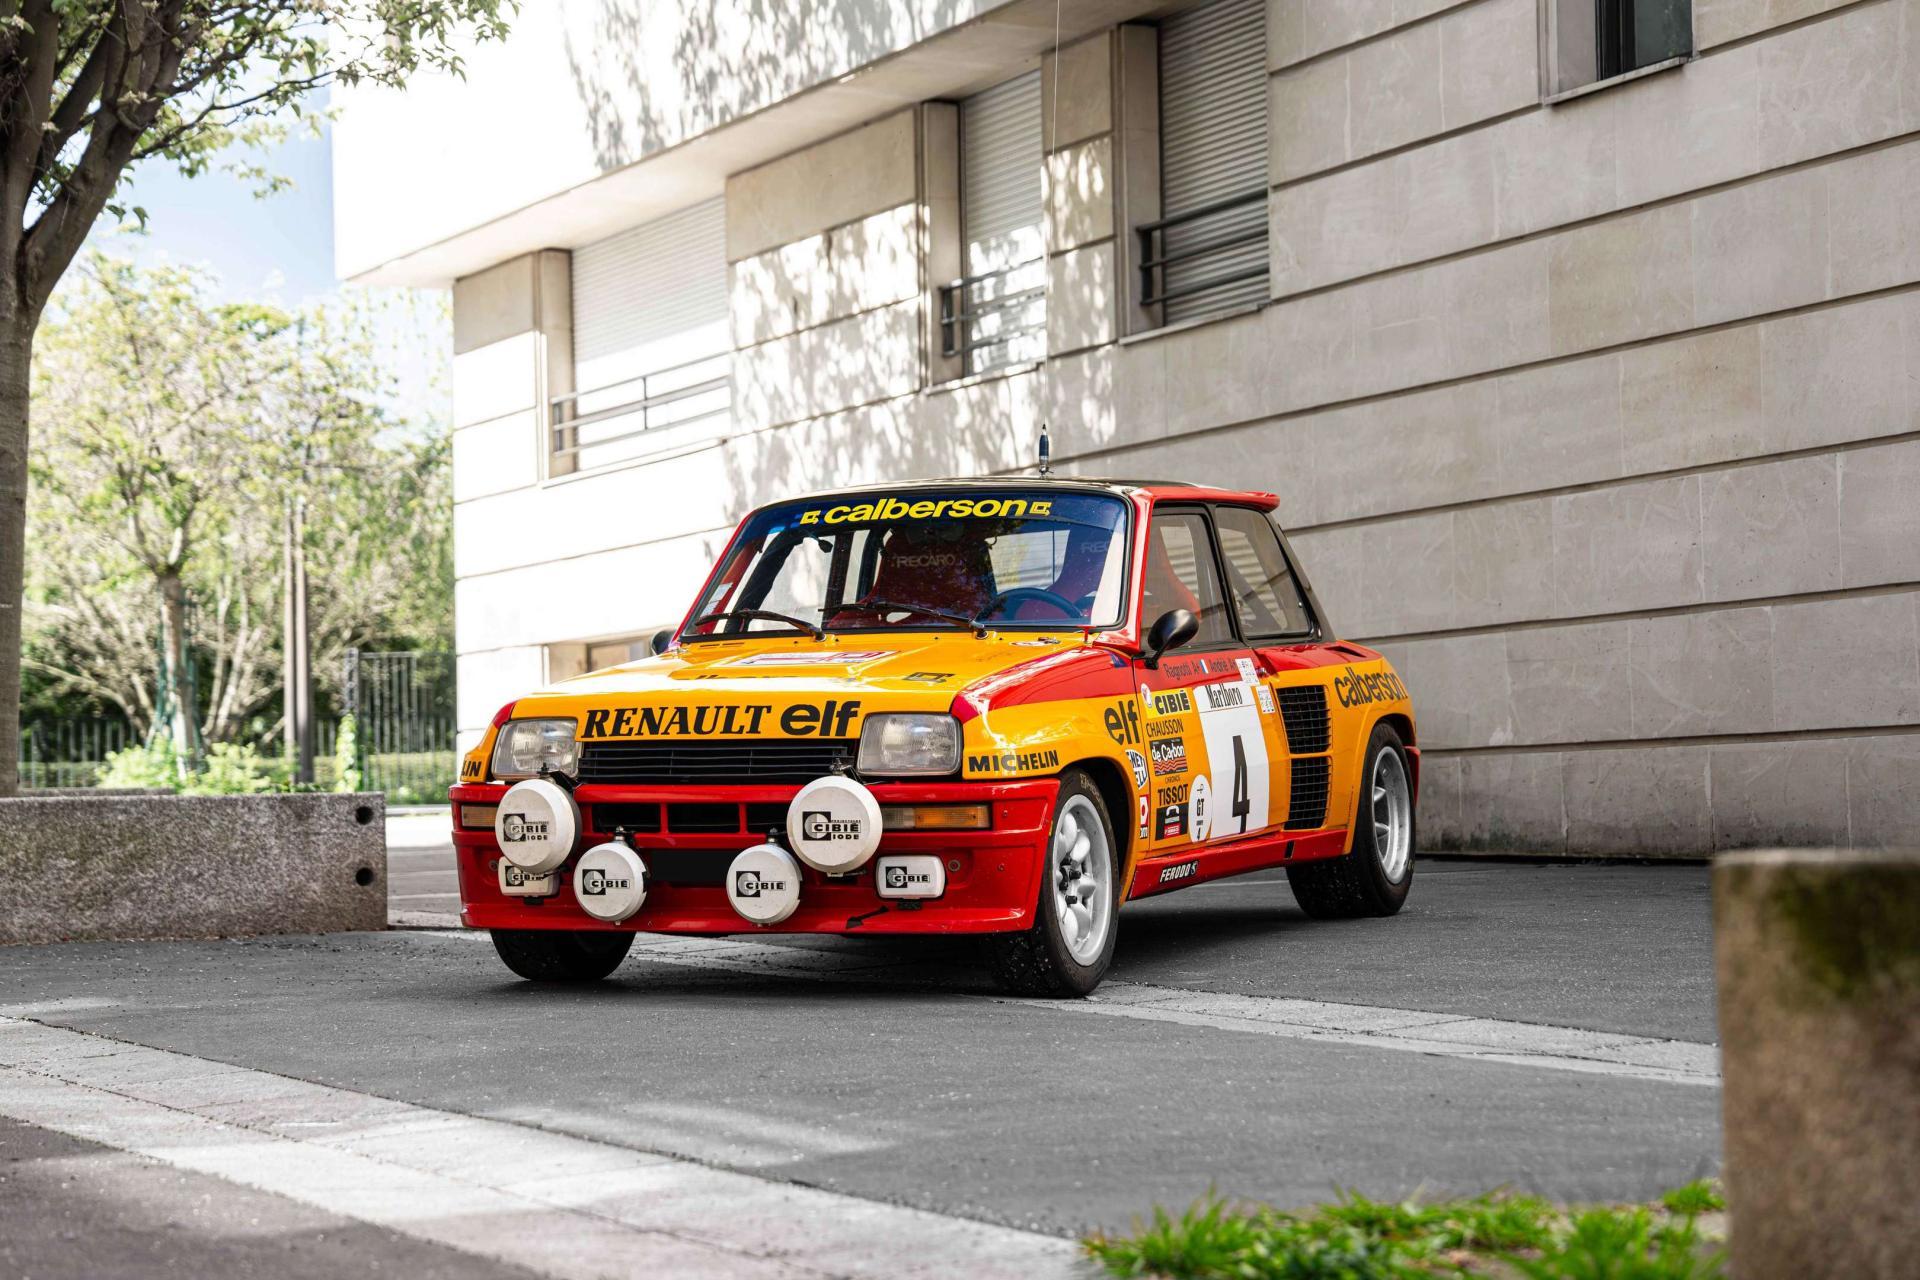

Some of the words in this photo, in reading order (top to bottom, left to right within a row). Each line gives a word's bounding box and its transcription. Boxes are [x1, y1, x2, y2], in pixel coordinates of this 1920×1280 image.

[824, 498, 1028, 524] calberson
[895, 553, 956, 568] RECARO
[1204, 682, 1243, 709] Marlboro
[1334, 666, 1408, 708] calberson
[580, 703, 772, 739] RENAULT
[780, 700, 861, 738] elf
[1104, 699, 1140, 746] elf
[1146, 718, 1185, 738] CHAUSSON
[968, 749, 1060, 773] MICHELIN
[1151, 745, 1162, 763] de
[1161, 742, 1186, 762] Carbon
[1157, 783, 1189, 807] TISSOT
[1231, 734, 1251, 834] 4
[1159, 863, 1190, 883] FERODO
